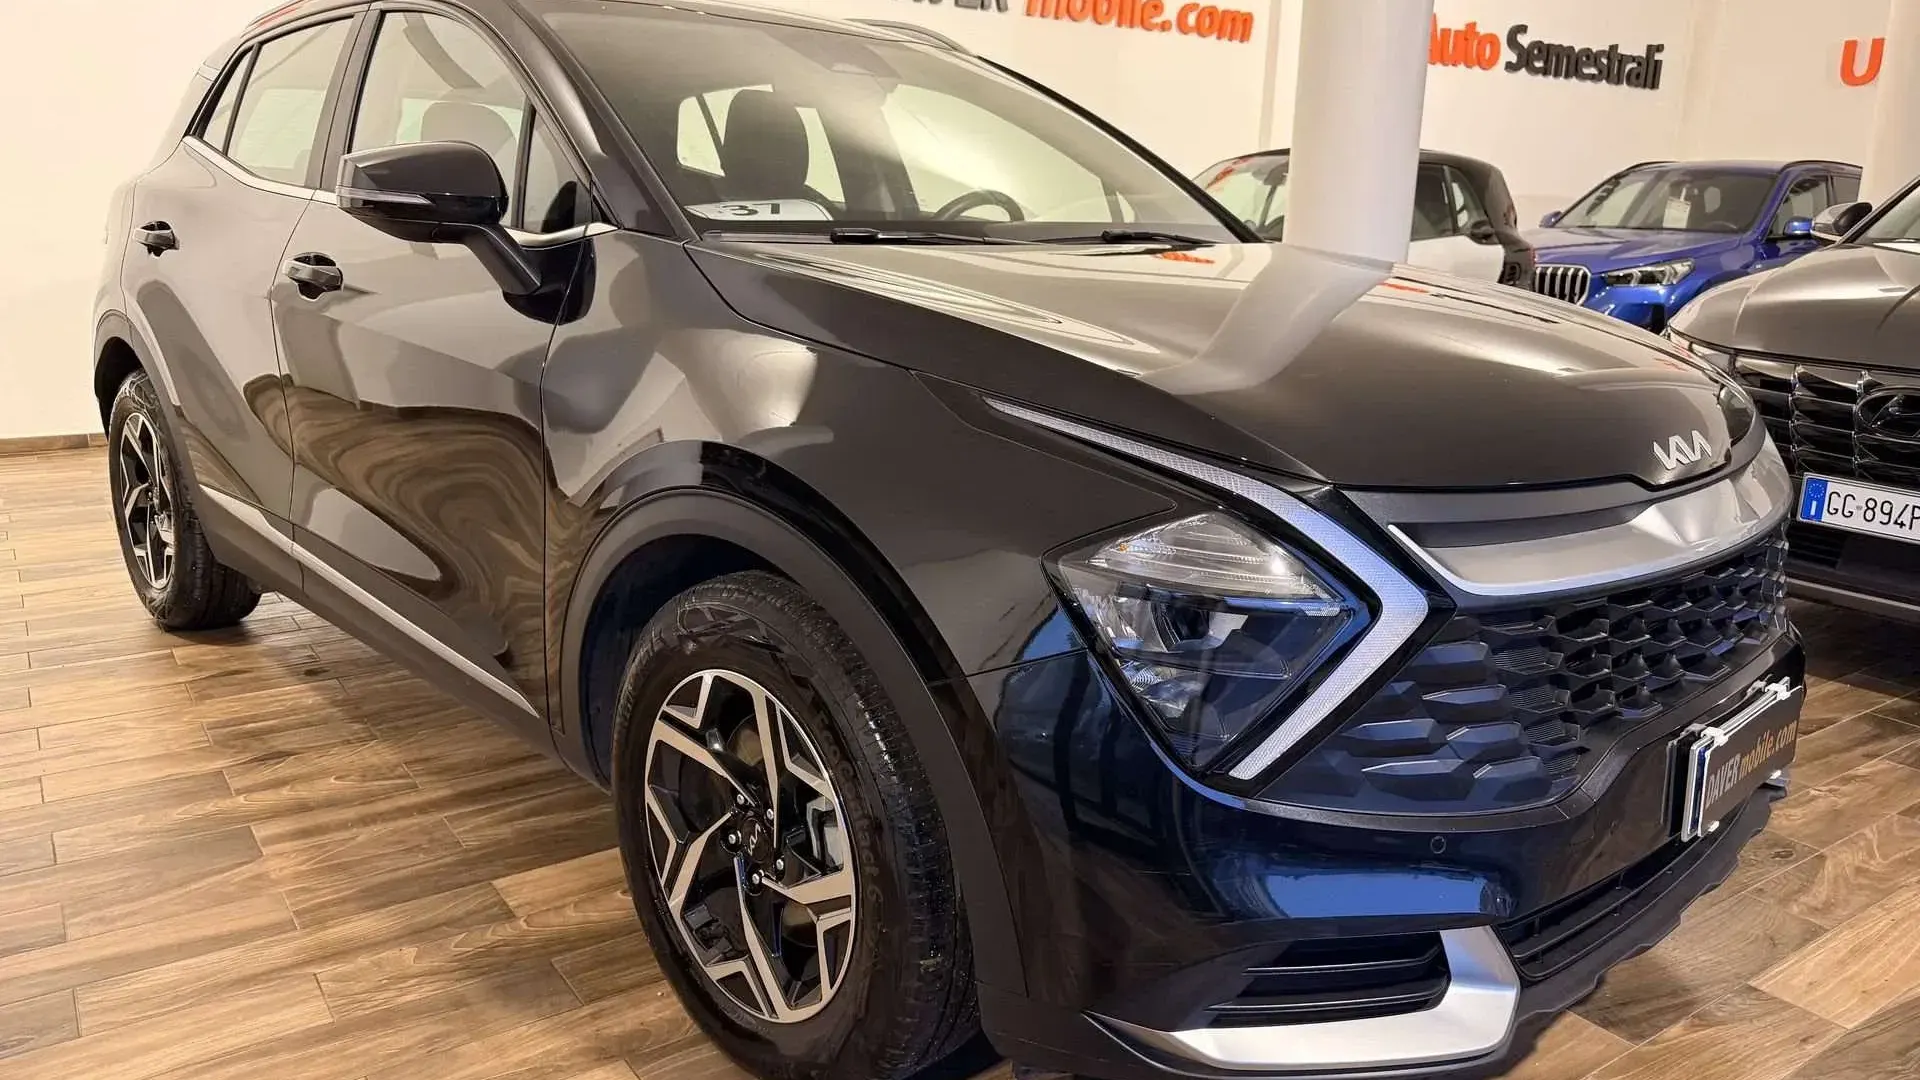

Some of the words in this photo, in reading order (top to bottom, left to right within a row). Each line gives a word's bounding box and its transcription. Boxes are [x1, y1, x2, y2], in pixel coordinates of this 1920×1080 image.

[1504, 24, 1664, 90] Semestrali
[1653, 429, 1713, 471] KIA
[1704, 752, 1742, 810] DAVER
[1738, 719, 1799, 781] mobile.com
